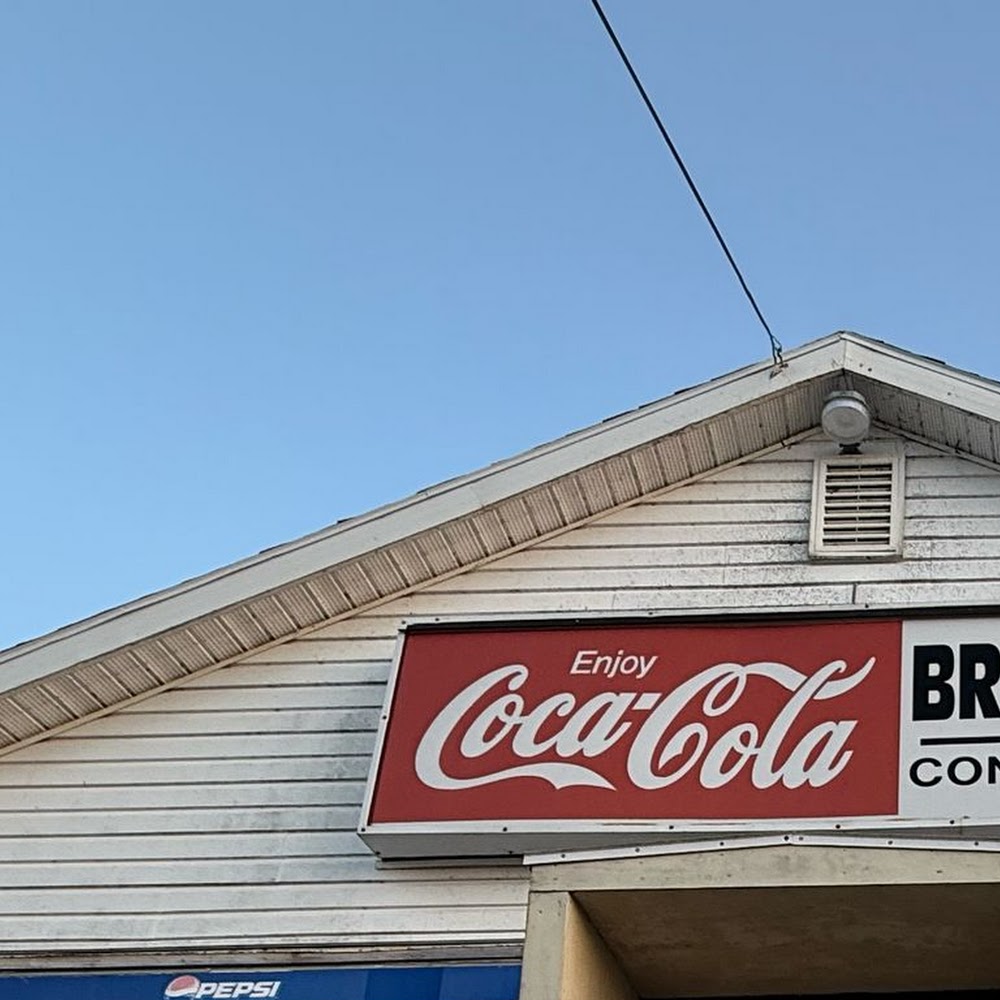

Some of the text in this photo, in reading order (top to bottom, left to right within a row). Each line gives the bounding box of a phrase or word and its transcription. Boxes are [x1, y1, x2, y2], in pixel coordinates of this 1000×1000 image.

[570, 650, 658, 678] Enjoy
[415, 656, 876, 790] Coca-Cola
[195, 981, 281, 998] PEPSI
